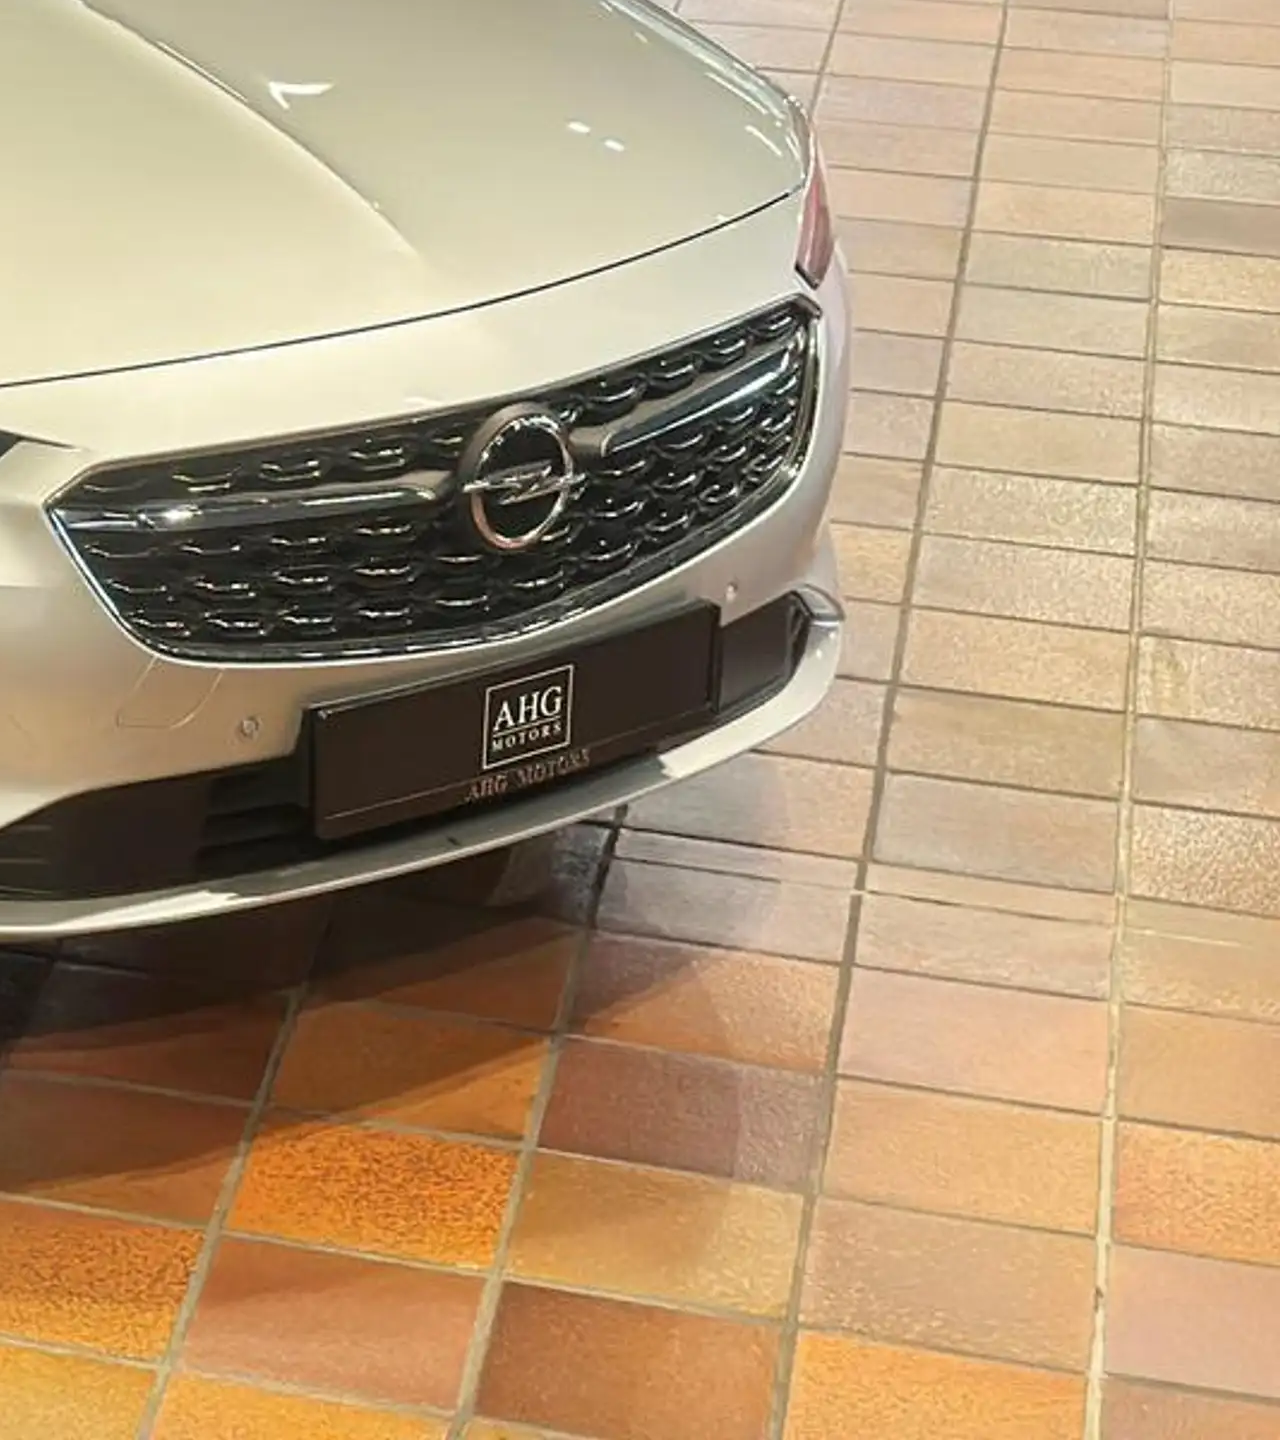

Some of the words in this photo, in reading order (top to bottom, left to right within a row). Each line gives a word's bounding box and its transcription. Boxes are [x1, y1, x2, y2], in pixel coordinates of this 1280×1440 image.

[492, 686, 563, 732] AHG
[491, 720, 562, 753] MOTORS
[464, 774, 509, 803] AHG
